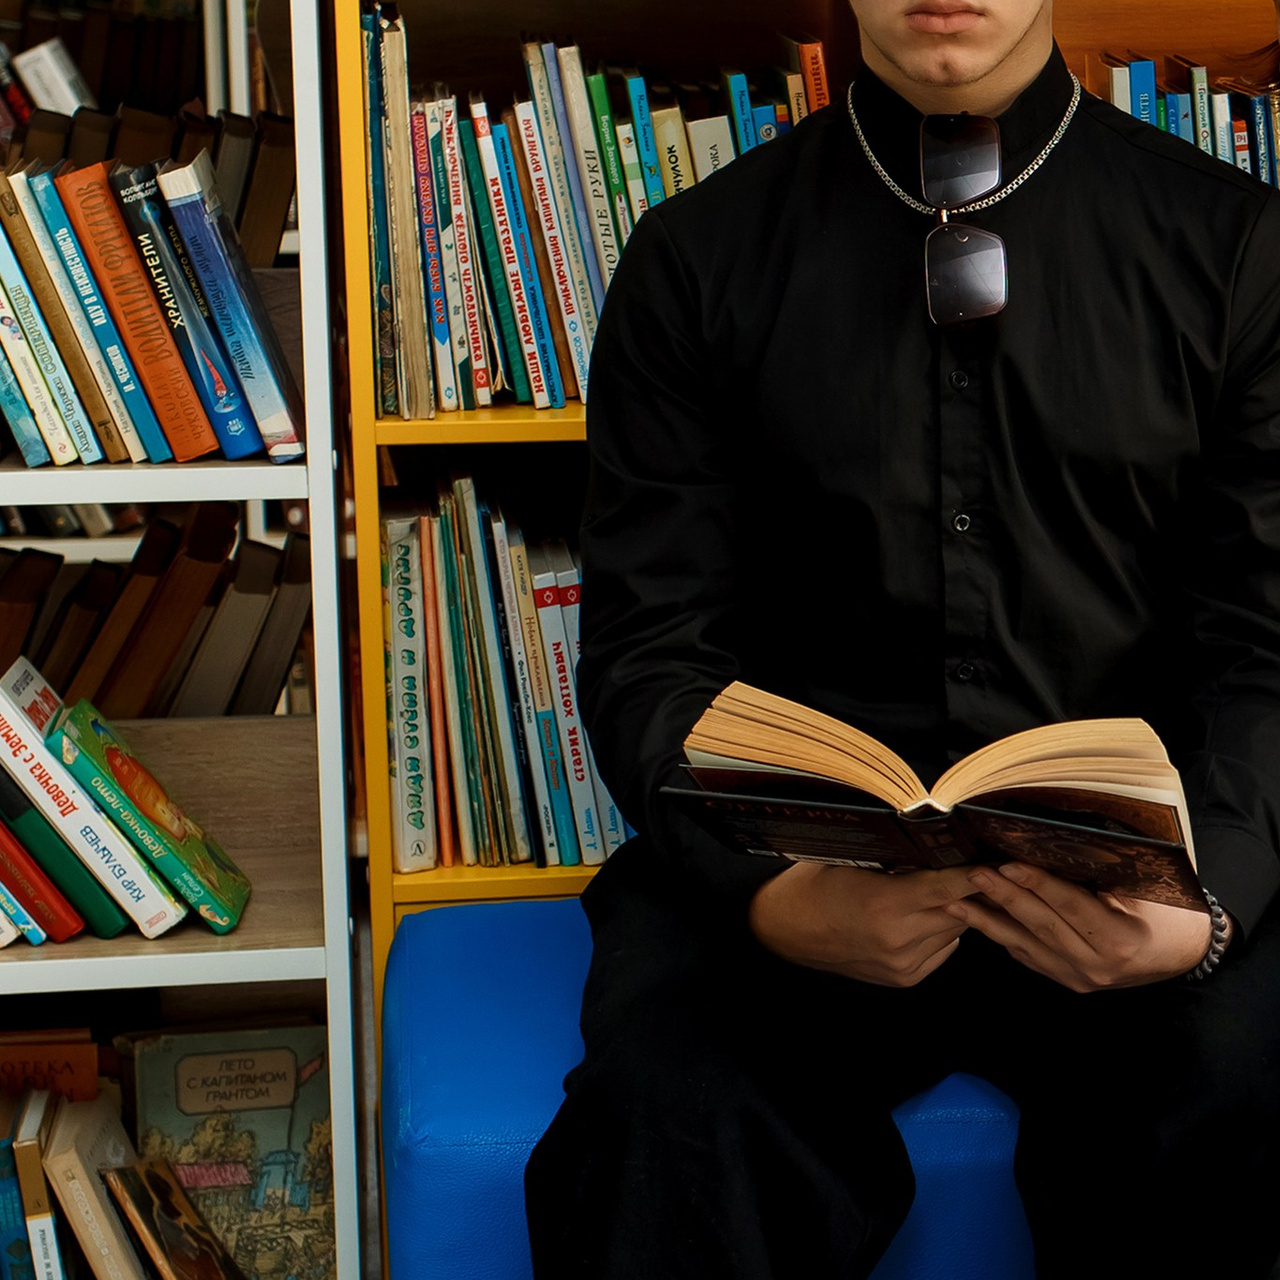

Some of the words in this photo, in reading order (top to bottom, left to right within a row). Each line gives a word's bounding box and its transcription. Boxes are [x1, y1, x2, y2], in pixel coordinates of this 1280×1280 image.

[491, 177, 516, 264] ПРАЗДНИКИ
[55, 227, 94, 296] НЕИЗВЕСТНОСТЬ
[137, 232, 185, 328] ХРАНИТЕЛИ
[90, 305, 107, 326] ИДУ
[510, 270, 533, 345] ЛЮБИМЫЕ
[529, 351, 544, 394] НАШИ
[394, 543, 414, 638] ДРУГИЕ
[552, 641, 574, 717] ХОТТАБЫЧ
[400, 676, 419, 749] СТЁПА
[566, 726, 586, 782] СТАРИК
[29, 768, 78, 819] Девочка
[406, 756, 424, 830] ДЯДЯ
[80, 825, 128, 879] БУЛЫЧЕВ
[119, 879, 146, 903] КИР
[200, 1072, 287, 1086] КАПИТАНОМ
[219, 1059, 255, 1069] ЛЕТО
[205, 1089, 269, 1102] ГРАНТОМ
